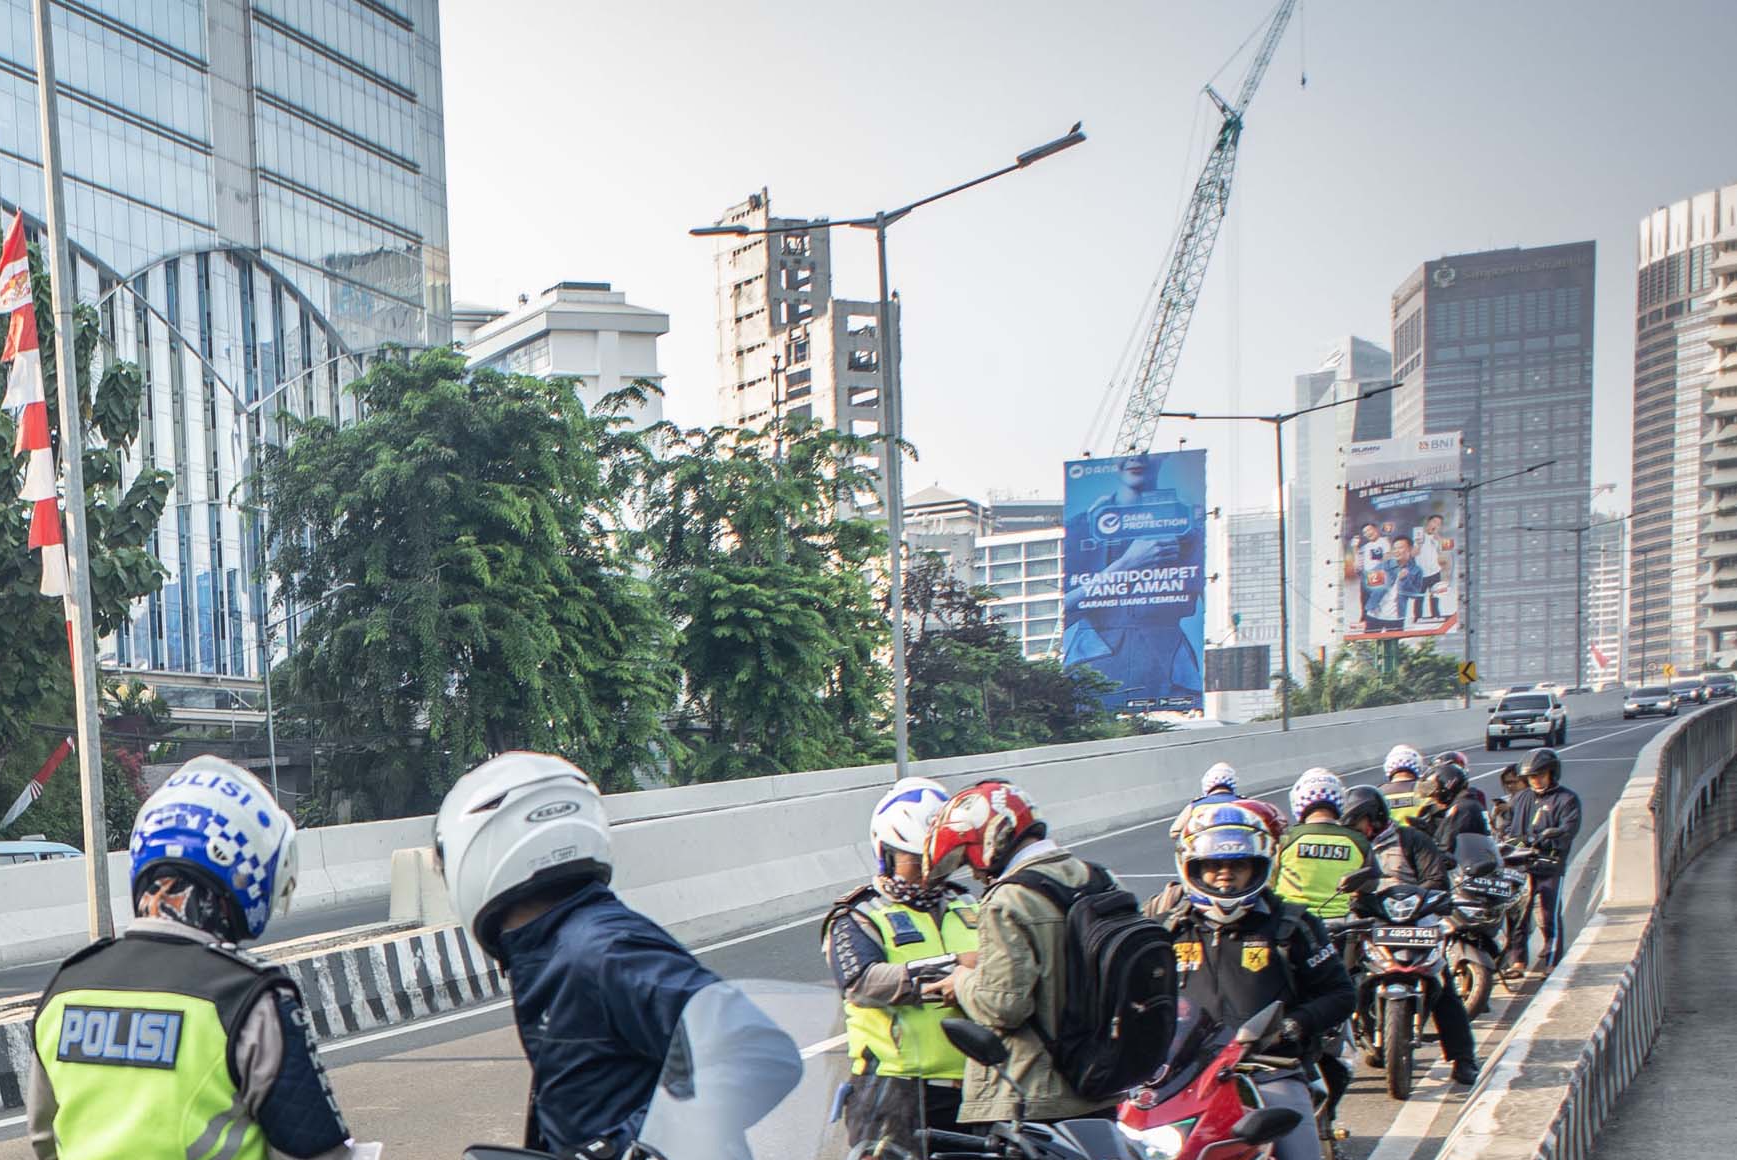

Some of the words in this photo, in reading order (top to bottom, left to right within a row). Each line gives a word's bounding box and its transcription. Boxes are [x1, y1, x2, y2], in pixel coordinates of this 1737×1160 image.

[1431, 438, 1454, 449] BNI
[1123, 512, 1153, 521] DANA
[1122, 518, 1188, 530] PROTECTION
[1070, 566, 1199, 587] #GANTIDOMPET
[1083, 583, 1128, 597] YANG
[1132, 579, 1184, 594] AMAN
[1078, 600, 1118, 609] GARANSI
[1120, 597, 1147, 606] UANG
[1149, 595, 1189, 604] KEMBALI
[1298, 844, 1349, 859] POLISI
[59, 1009, 181, 1063] POLISI
